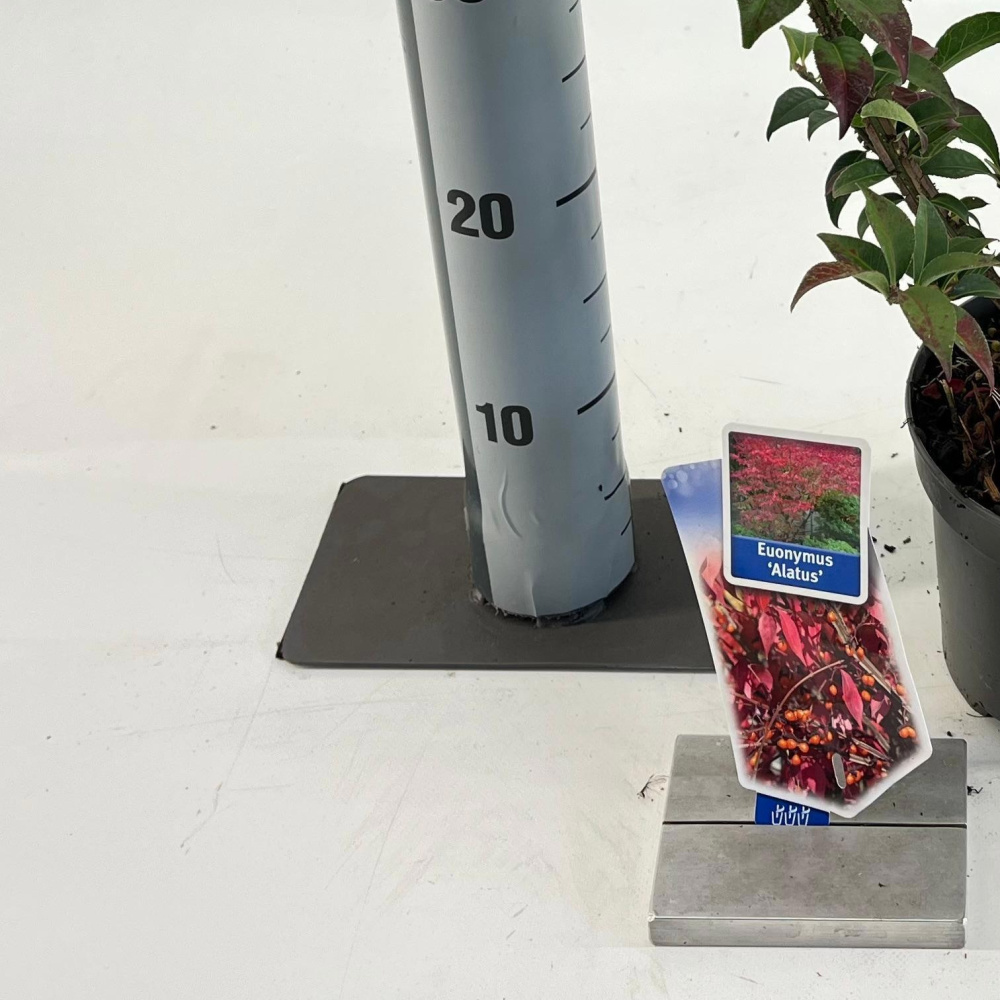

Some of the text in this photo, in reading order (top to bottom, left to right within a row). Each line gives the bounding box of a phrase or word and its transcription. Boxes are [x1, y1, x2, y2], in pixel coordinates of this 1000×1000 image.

[447, 189, 515, 240] 20
[475, 403, 534, 447] 10
[757, 541, 834, 567] Euonymus
